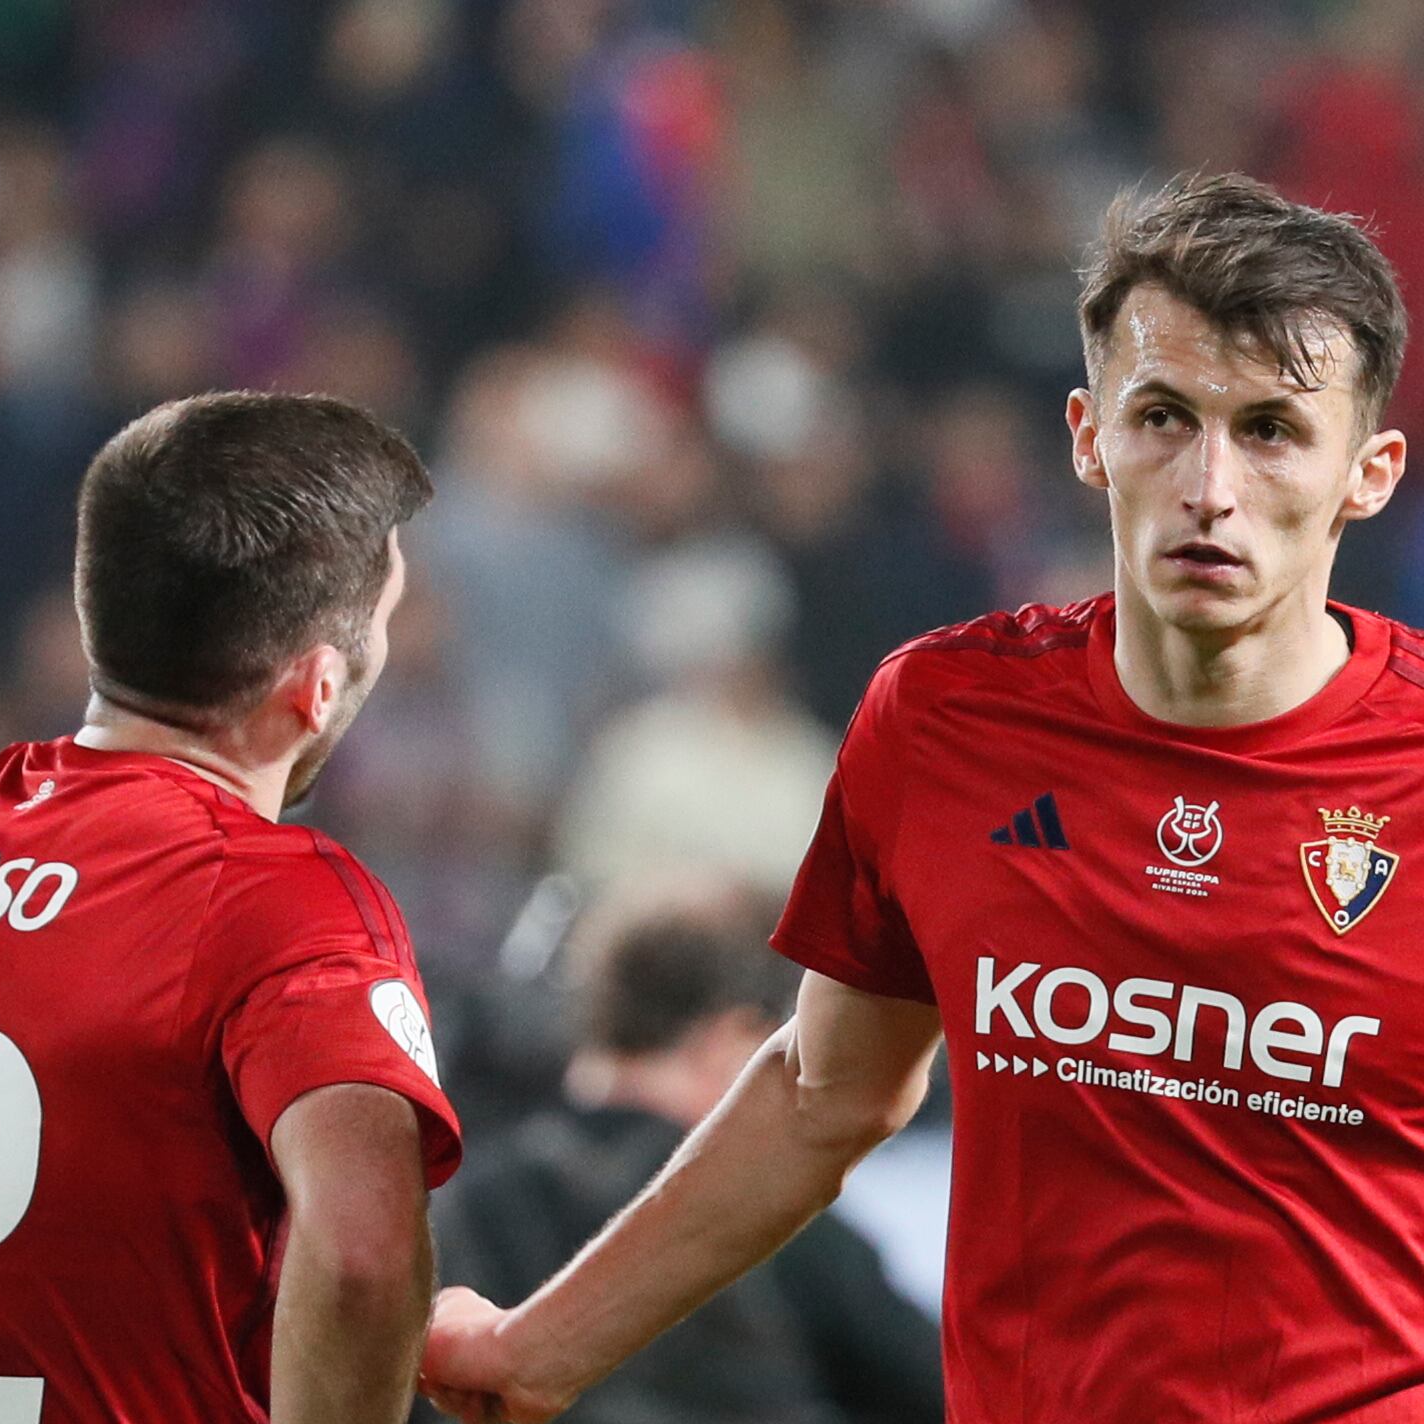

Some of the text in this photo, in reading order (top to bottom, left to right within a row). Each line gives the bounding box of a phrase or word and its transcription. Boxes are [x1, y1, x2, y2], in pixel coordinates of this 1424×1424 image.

[1308, 851, 1388, 876] C A
[1145, 866, 1220, 885] SUPERCOPA
[1333, 909, 1350, 926] O
[1057, 1057, 1365, 1126] Climatización eficiente
